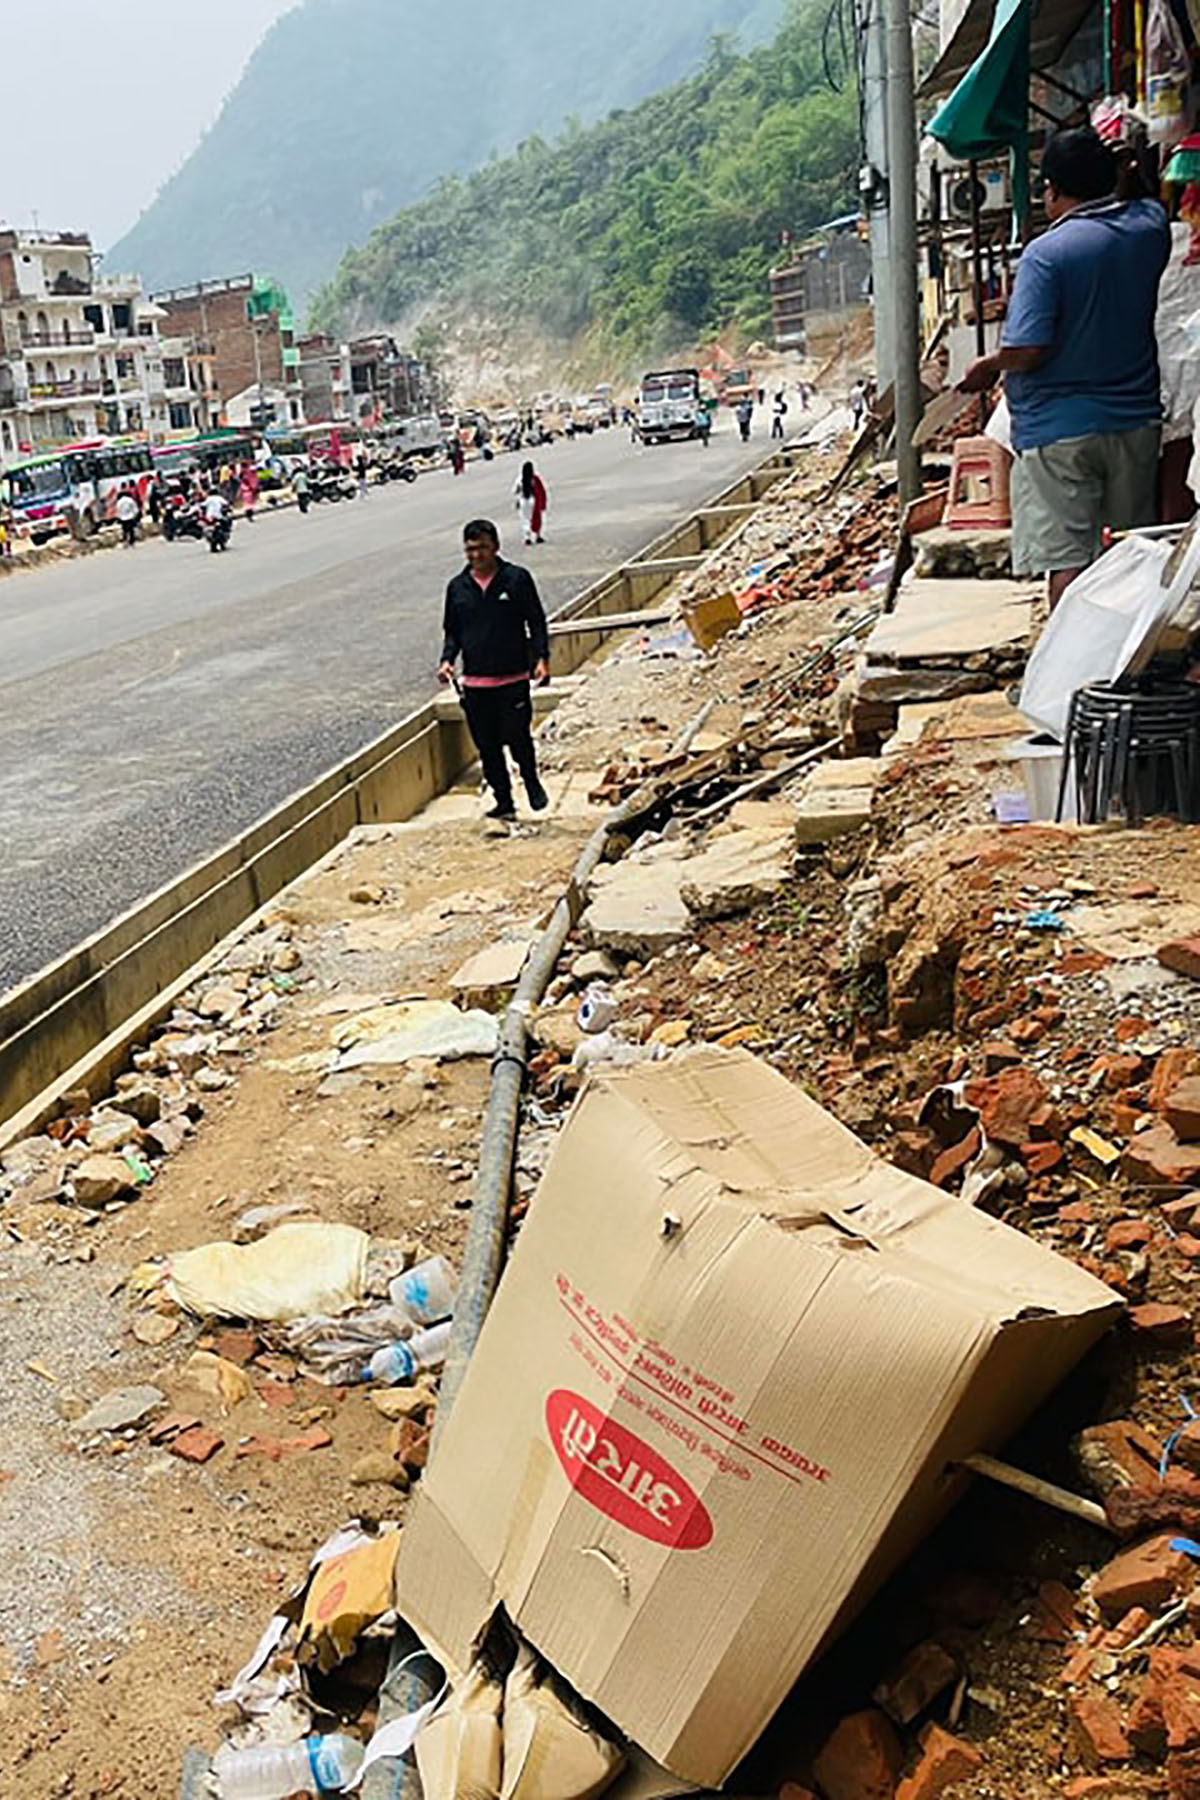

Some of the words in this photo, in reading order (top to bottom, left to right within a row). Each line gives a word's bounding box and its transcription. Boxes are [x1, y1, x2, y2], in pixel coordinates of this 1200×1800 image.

[698, 1396, 750, 1435] आरती
[561, 1408, 681, 1527] आरती
[760, 1436, 831, 1482] उत्पादक
